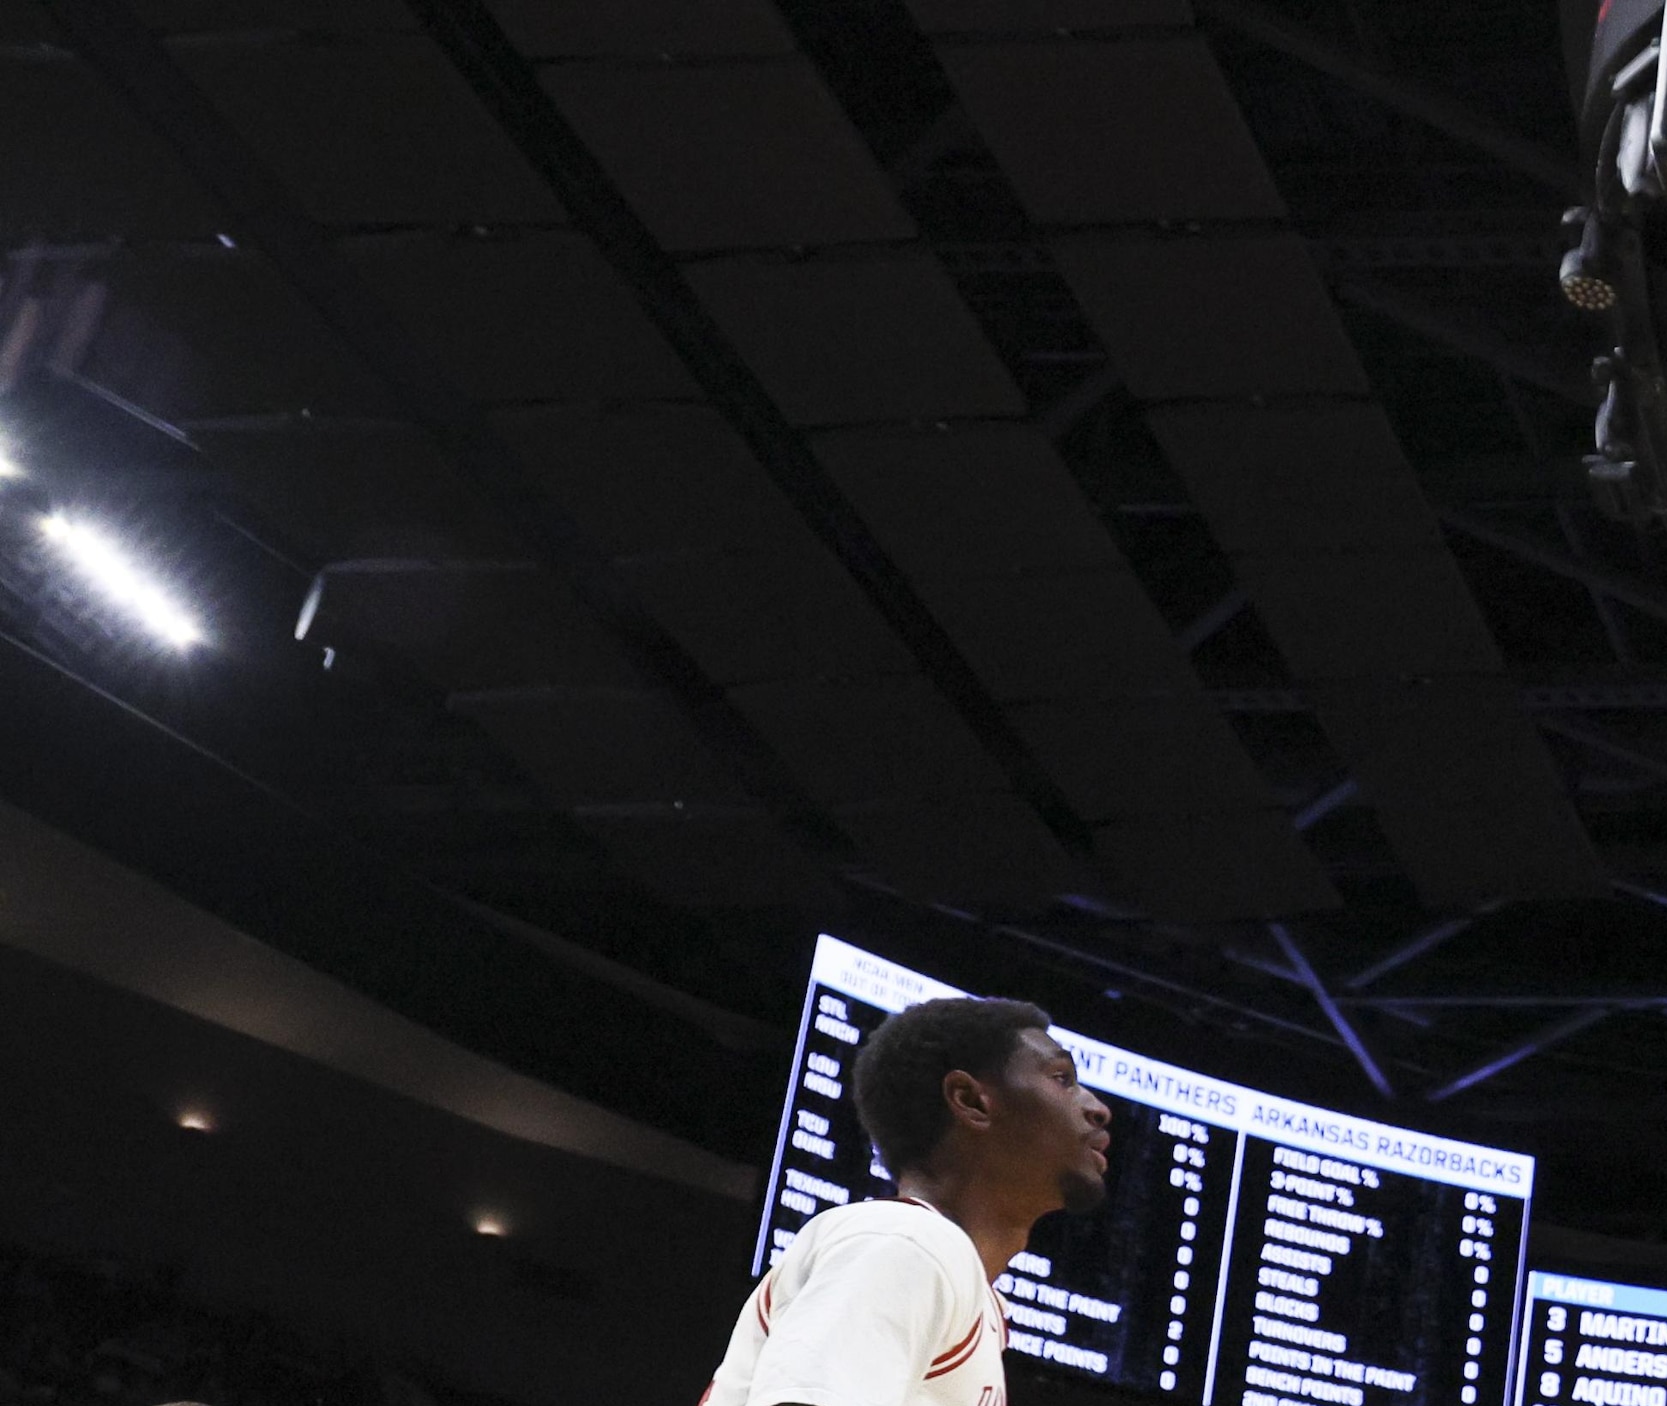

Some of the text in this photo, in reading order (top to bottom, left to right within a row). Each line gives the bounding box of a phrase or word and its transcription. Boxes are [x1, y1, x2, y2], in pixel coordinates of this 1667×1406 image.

[1114, 1061, 1238, 1116] PANTHERS
[1252, 1104, 1523, 1184] ARKANSAS RAZORBACKS
[1264, 1218, 1350, 1255] REBOUNDS
[1261, 1243, 1332, 1275] ASSISTS
[1258, 1267, 1320, 1297] STEALS
[1542, 1281, 1614, 1305] PLAYER
[1255, 1291, 1320, 1322] BLOCKS
[1547, 1306, 1567, 1332] 3
[1253, 1315, 1346, 1353] TURNOVERS
[1249, 1340, 1312, 1371] POINTS
[1333, 1359, 1365, 1383] THE
[1364, 1366, 1417, 1392] PAINT
[1544, 1339, 1563, 1365] 5
[1245, 1365, 1302, 1394] BENCH
[1539, 1372, 1560, 1398] 8
